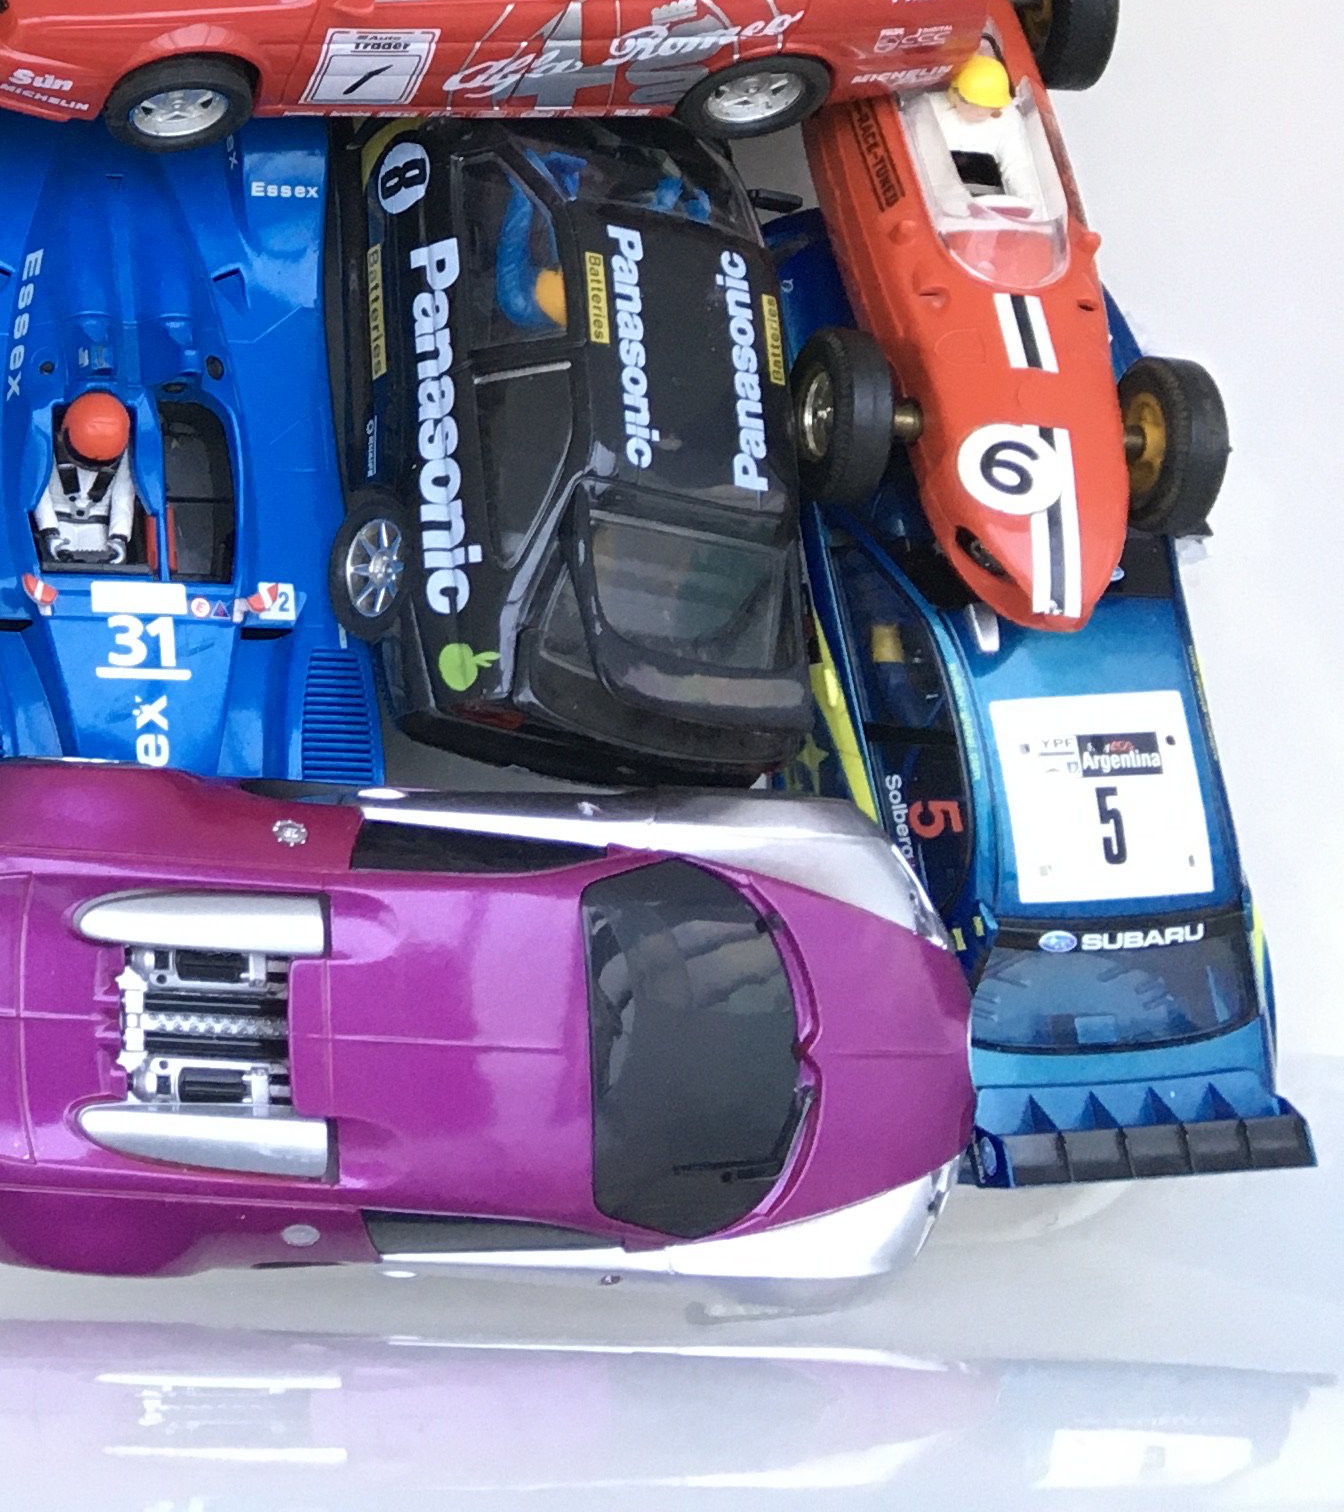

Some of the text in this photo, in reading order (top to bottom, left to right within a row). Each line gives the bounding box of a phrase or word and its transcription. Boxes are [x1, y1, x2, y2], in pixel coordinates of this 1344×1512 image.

[352, 41, 411, 54] Trader
[443, 41, 584, 100] Alfa
[603, 10, 805, 66] Romeo
[0, 82, 90, 112] MICHELIN
[851, 64, 954, 86] MICHELIN
[250, 182, 319, 199] Essex
[381, 159, 426, 199] 8
[6, 248, 45, 401] Essex
[367, 247, 385, 376] Batteries
[588, 254, 606, 342] Batteries
[607, 225, 660, 470] Panasonic
[765, 296, 784, 384] Batteries
[717, 250, 769, 492] Panasonic
[410, 237, 482, 615] Panasonic
[980, 441, 1041, 496] 6
[107, 615, 177, 668] 31
[1040, 737, 1074, 751] YPF
[1082, 749, 1163, 772] Argentina
[909, 799, 964, 839] 5
[1095, 786, 1127, 864] 5
[1081, 923, 1205, 951] SUBARU
